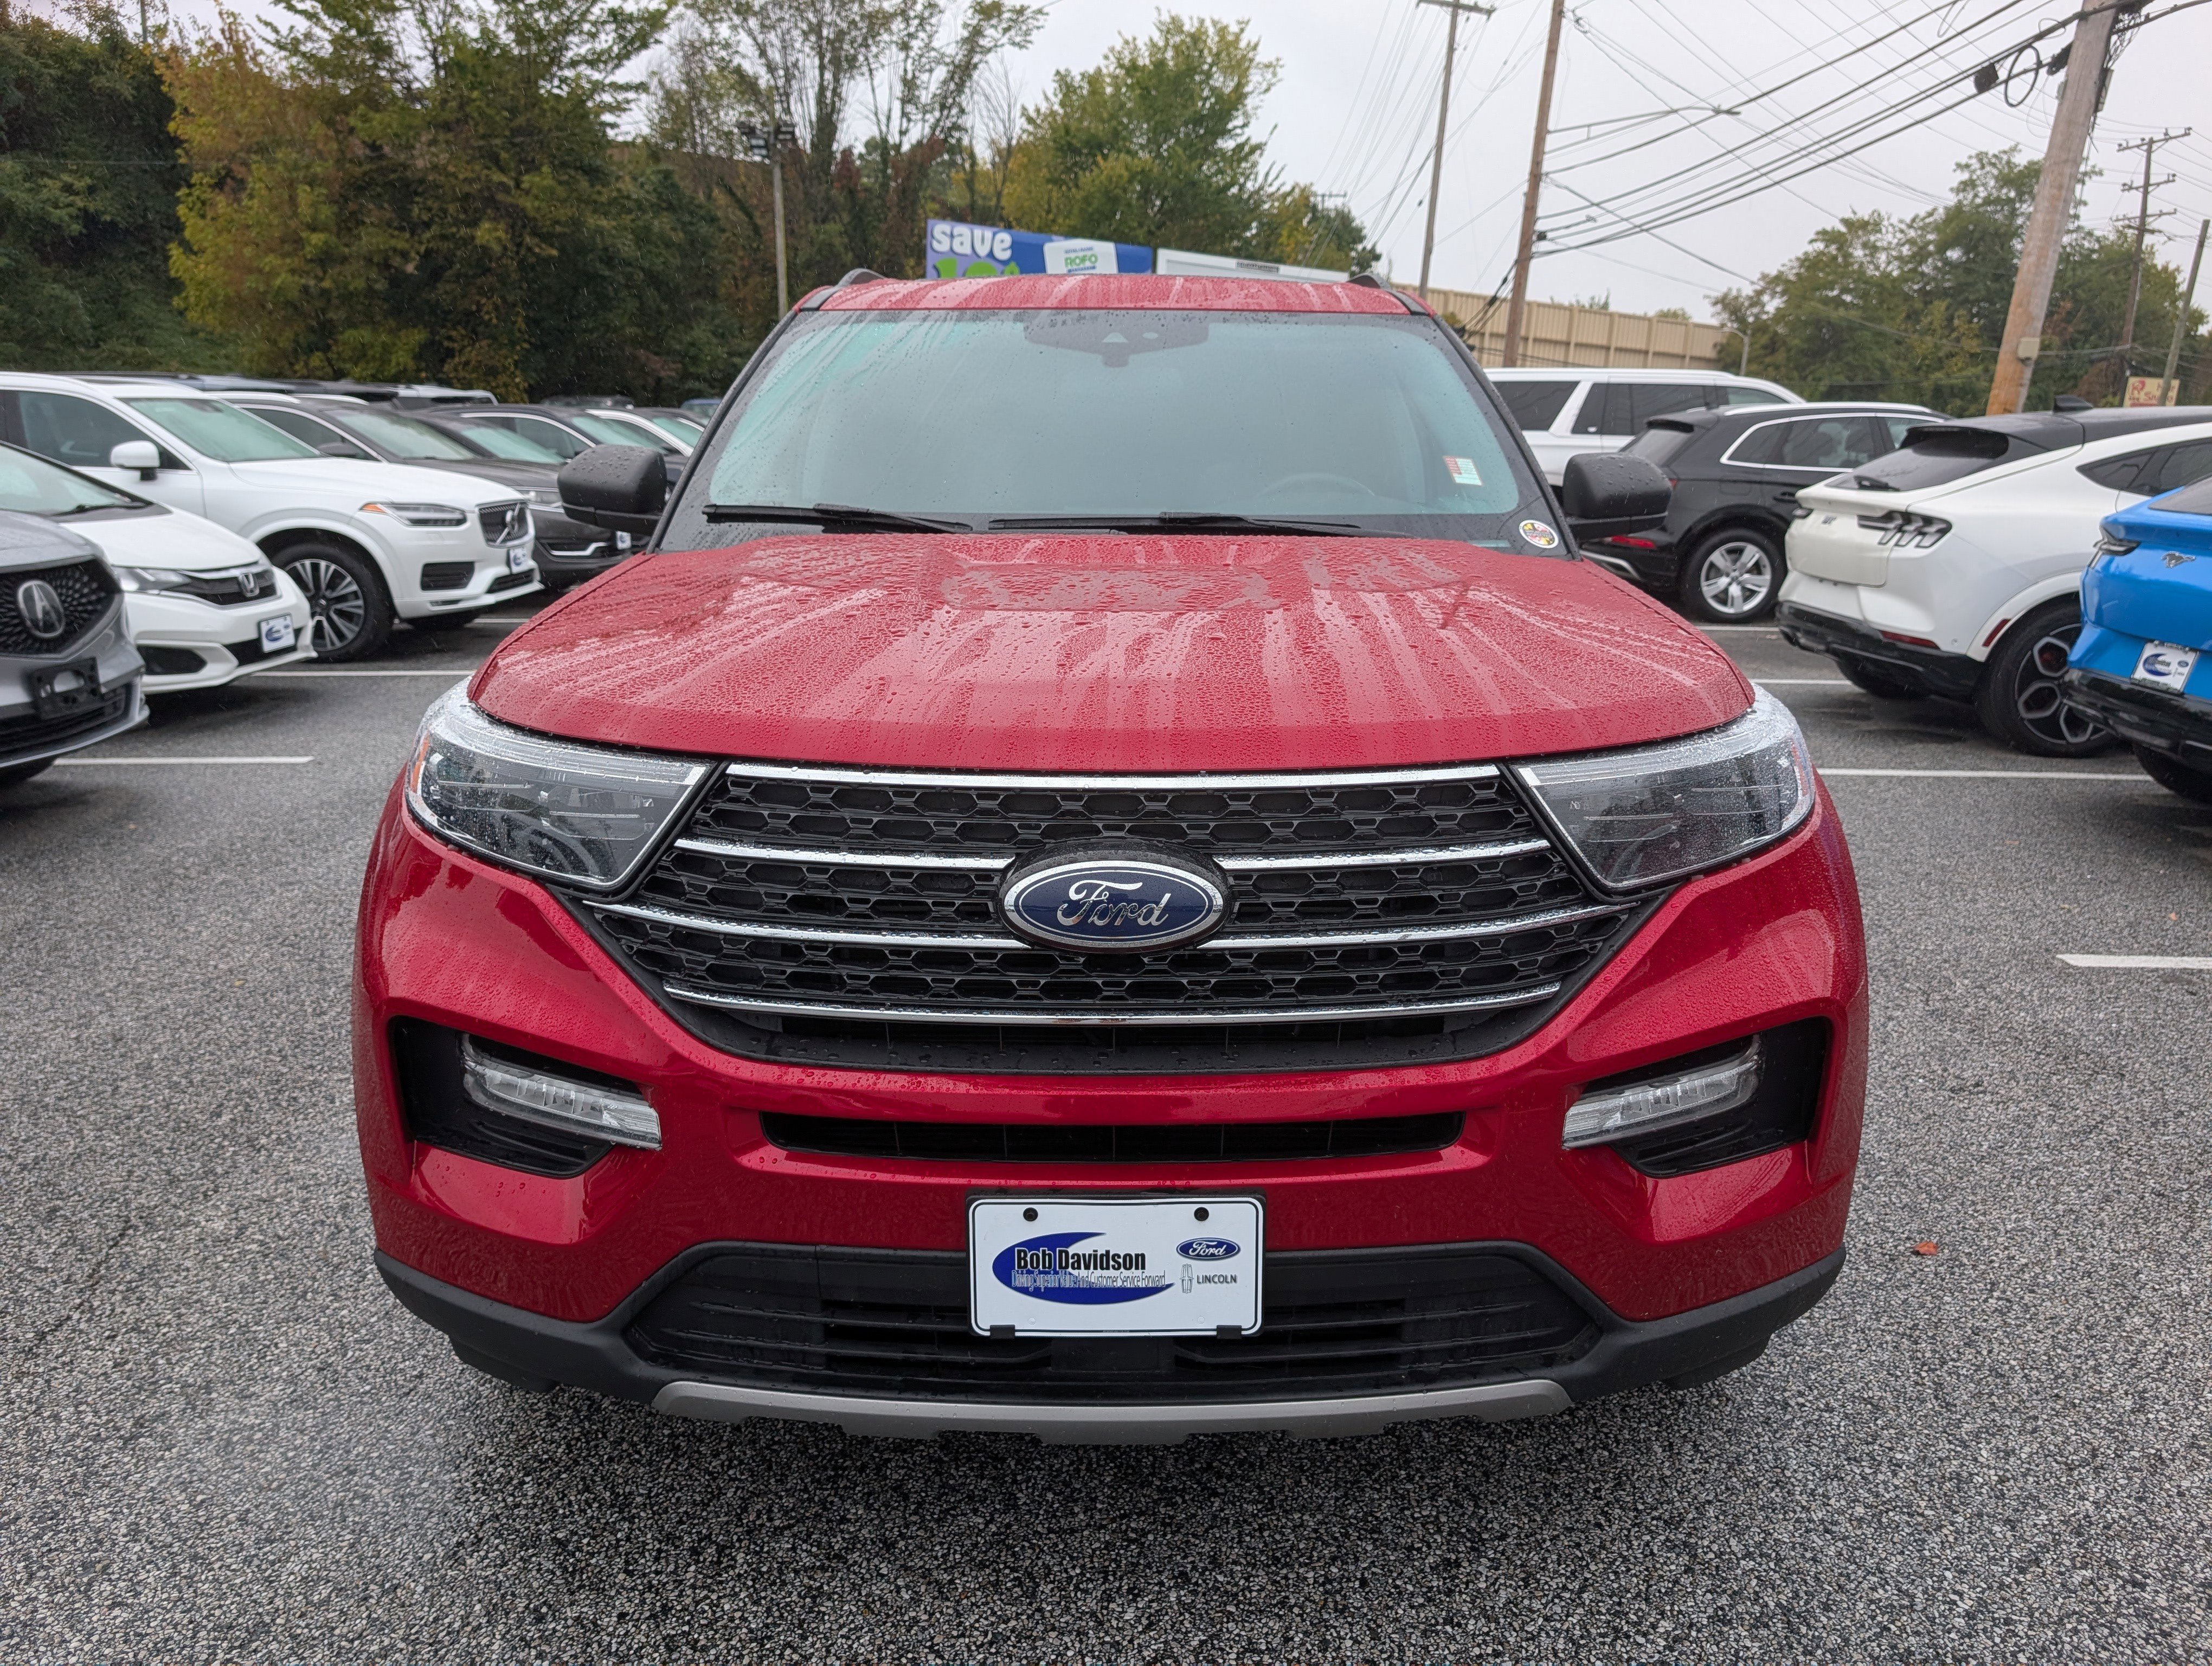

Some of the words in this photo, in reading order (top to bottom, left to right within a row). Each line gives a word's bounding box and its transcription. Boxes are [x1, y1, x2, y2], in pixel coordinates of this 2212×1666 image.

[931, 223, 1013, 261] save
[1064, 253, 1098, 268] ROFO
[1057, 880, 1172, 926] Ford
[1188, 1240, 1227, 1256] Ford
[1015, 1248, 1053, 1271] Bob
[1057, 1248, 1146, 1271] Davidson
[1012, 1270, 1034, 1292] Driving
[1034, 1270, 1059, 1292] Superior
[1059, 1270, 1077, 1287] Value
[1077, 1270, 1090, 1287] And
[1090, 1271, 1119, 1287] Customer
[1120, 1271, 1140, 1287] Service
[1141, 1270, 1166, 1287] Forward
[1196, 1274, 1237, 1284] LINCOLN
